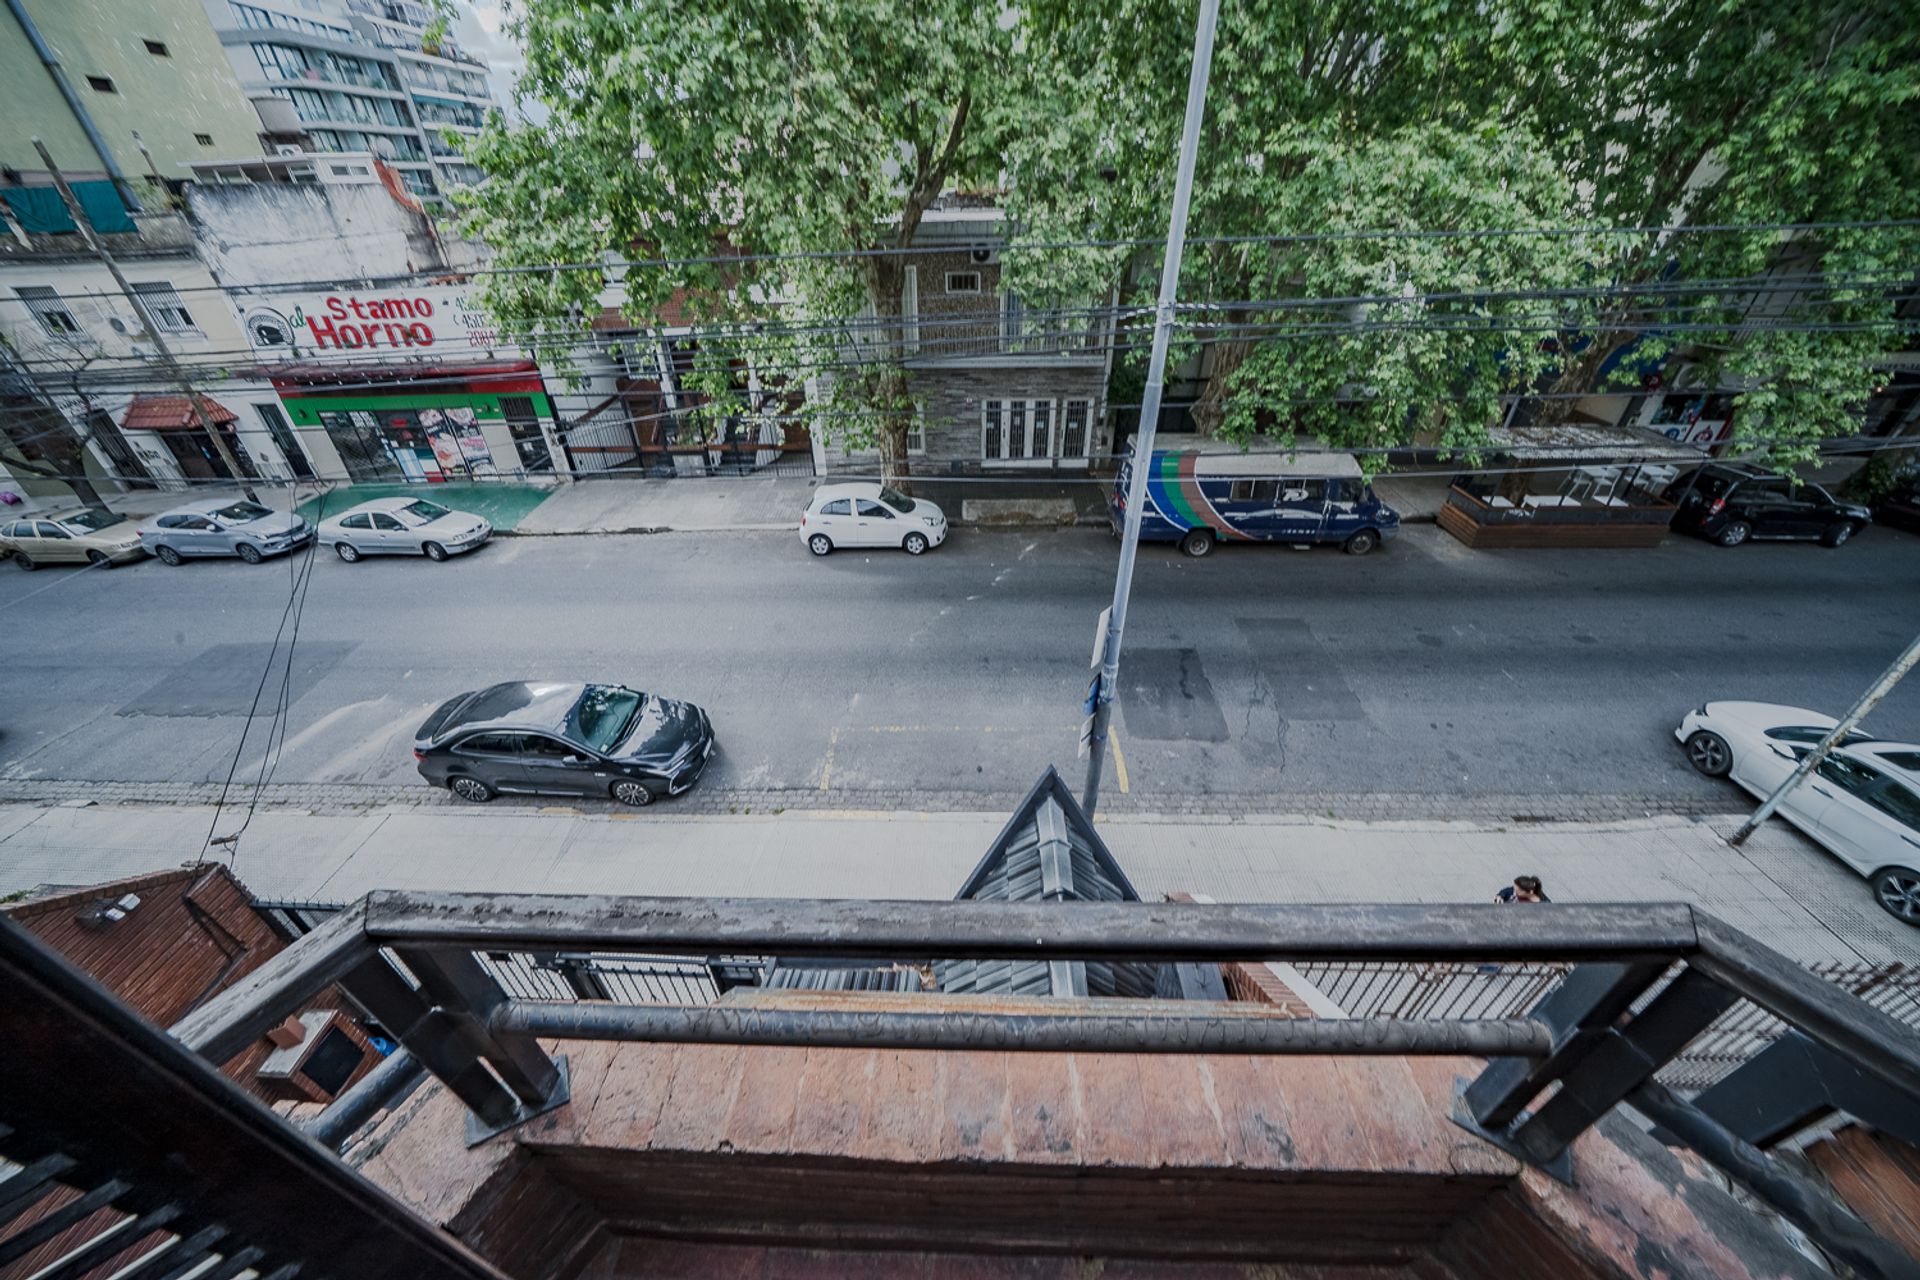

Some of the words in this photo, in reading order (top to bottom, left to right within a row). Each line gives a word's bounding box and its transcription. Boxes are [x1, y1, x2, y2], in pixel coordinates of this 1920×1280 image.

[289, 305, 307, 328] al
[326, 296, 433, 320] Stamo
[305, 314, 433, 349] Horno
